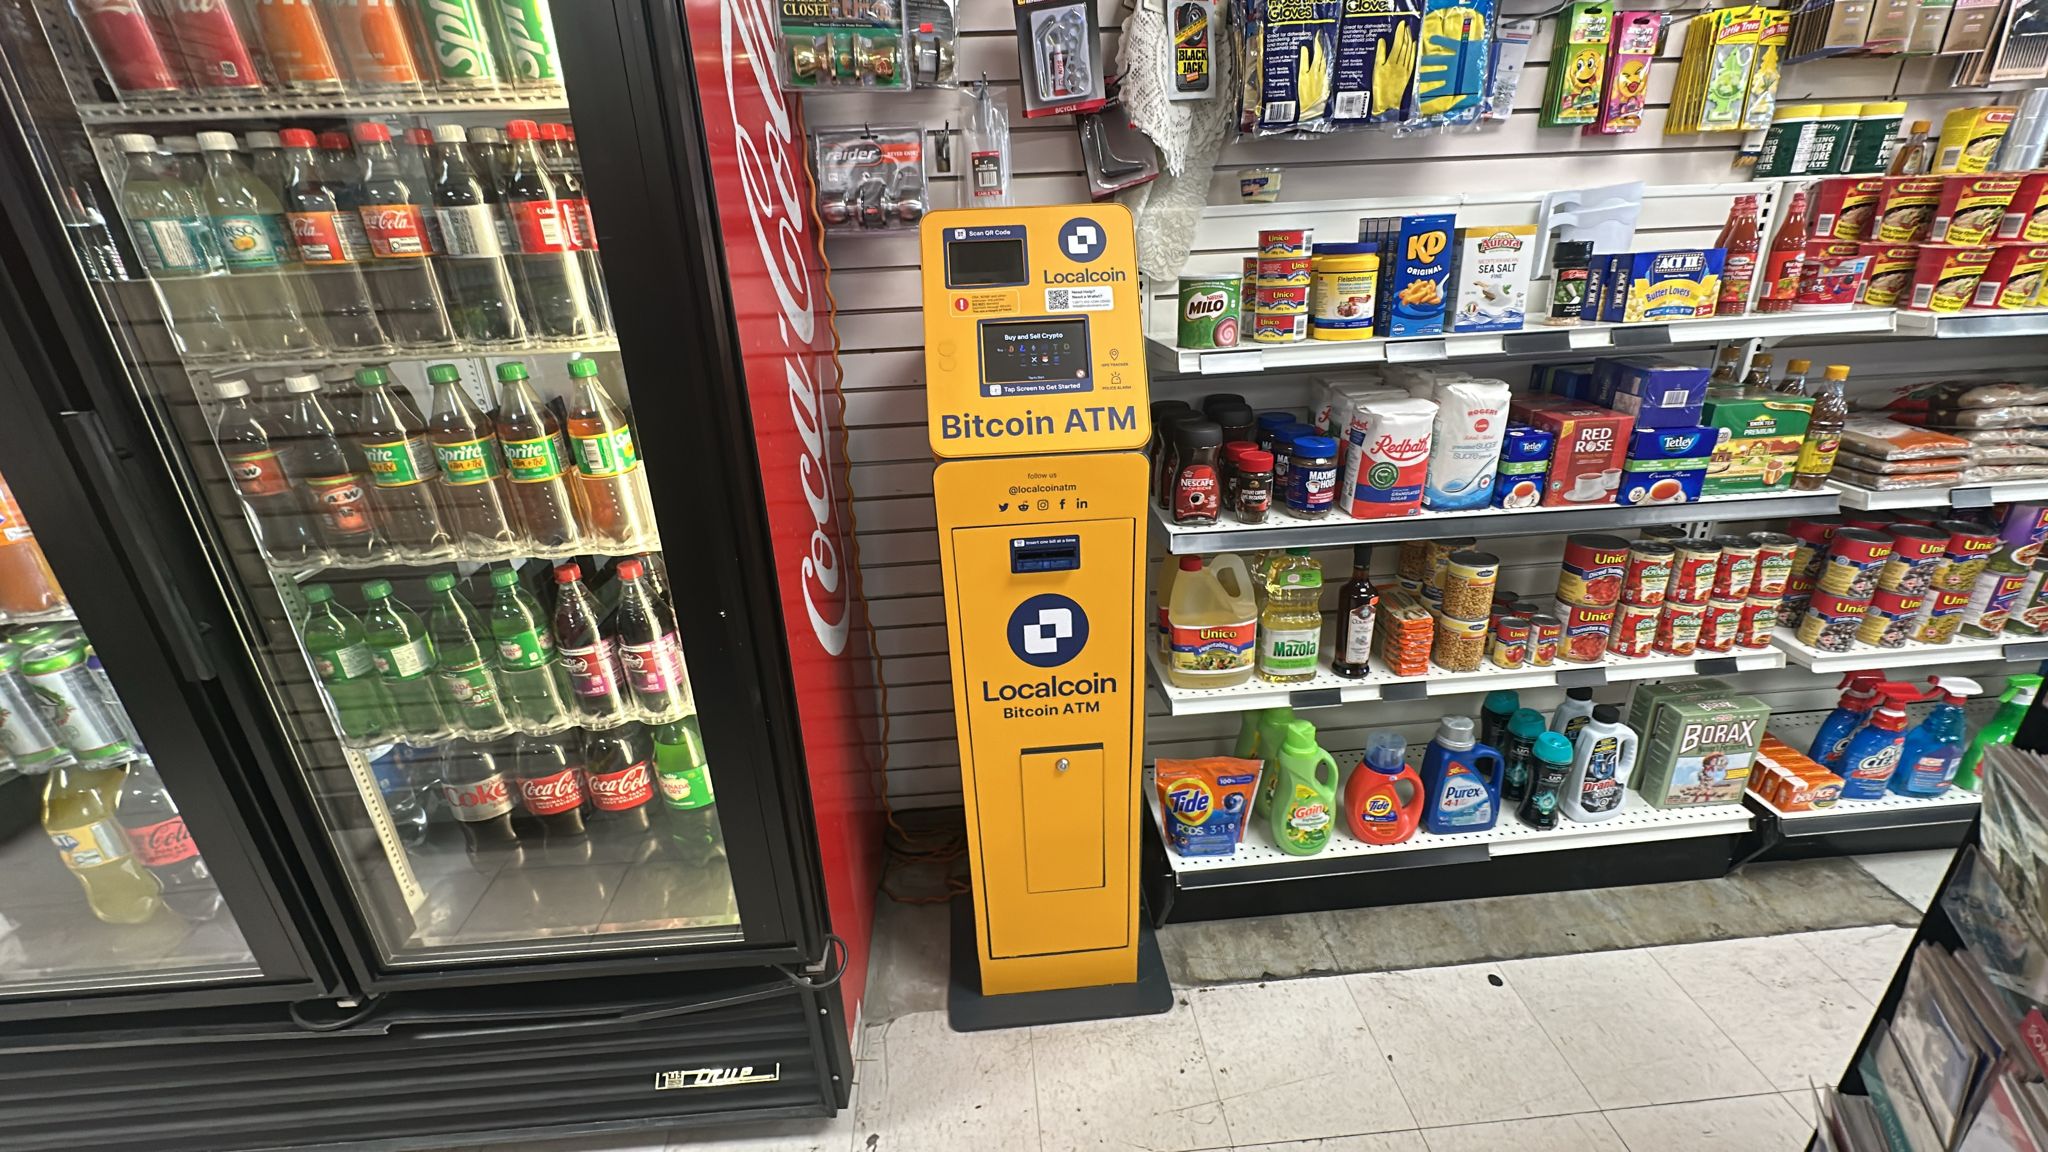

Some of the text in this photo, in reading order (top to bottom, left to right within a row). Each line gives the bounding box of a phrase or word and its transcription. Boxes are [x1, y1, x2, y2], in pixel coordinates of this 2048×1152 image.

[784, 4, 828, 16] CLOSET
[1347, 0, 1395, 11] Glove
[1268, 5, 1312, 21] Gloves
[1720, 22, 1759, 38] Little Trees
[1178, 49, 1207, 61] BLACK
[1182, 61, 1204, 73] JACK
[1055, 105, 1077, 114] BICYCLE
[825, 148, 874, 161] raider
[1407, 230, 1447, 264] KD
[1479, 238, 1522, 251] Aurora
[1478, 263, 1516, 274] SEA SALT
[1660, 256, 1698, 269] ACT II
[1044, 268, 1125, 284] Localcoin
[1407, 264, 1442, 276] ORIGINAL
[1646, 285, 1689, 301] Butter Lovers
[1189, 300, 1224, 315] MILO
[941, 406, 1136, 440] Bitcoin ATM
[1582, 428, 1612, 440] RED
[1370, 432, 1430, 458] Redpath
[1523, 442, 1543, 451] Tetley
[1575, 440, 1614, 452] ROSE
[1664, 437, 1695, 449] Tetley
[438, 444, 482, 462] Sprite
[503, 443, 542, 459] Sprite
[1009, 484, 1076, 495] @localcoinatm
[1200, 629, 1236, 639] Unico
[1198, 643, 1228, 653] Vegetable
[1273, 640, 1316, 657] Mazola
[983, 672, 1116, 702] Localcoin
[1004, 701, 1100, 719] Bitcoin ATM
[1680, 719, 1758, 754] BORAX
[1446, 787, 1480, 798] Purex
[1793, 789, 1834, 804] bounce
[1168, 789, 1209, 813] Tide
[1369, 800, 1390, 811] Tide
[1296, 805, 1323, 818] Gain
[1177, 824, 1204, 834] PODS
